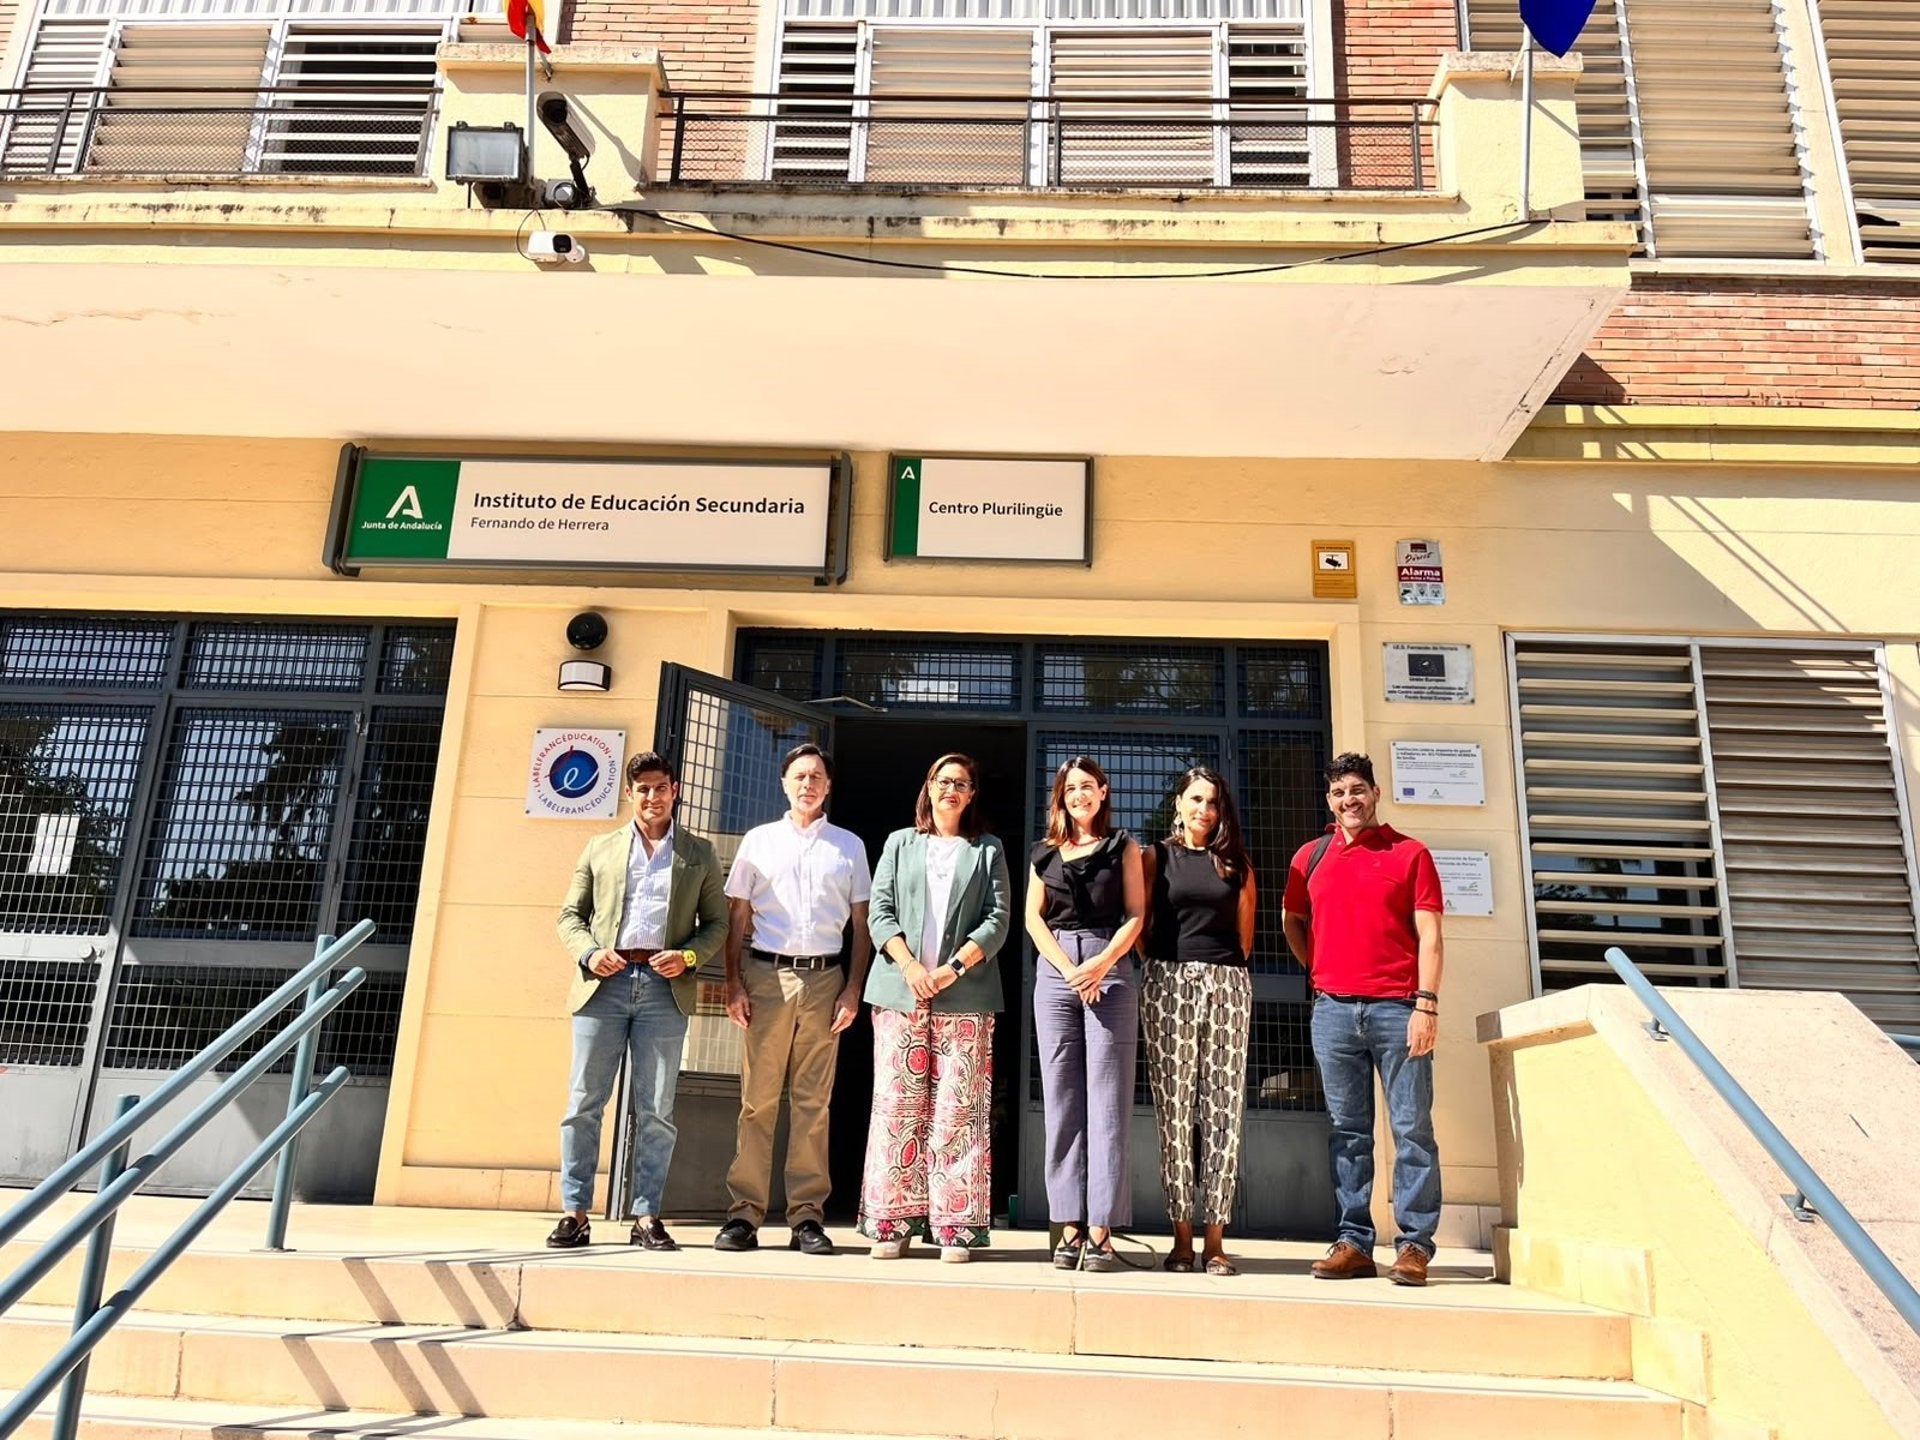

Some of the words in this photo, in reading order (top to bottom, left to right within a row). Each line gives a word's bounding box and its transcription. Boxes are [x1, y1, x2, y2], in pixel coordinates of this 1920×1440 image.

[473, 492, 557, 509] Instituto
[562, 493, 586, 510] de
[590, 494, 690, 512] Educación
[695, 497, 805, 514] Secundaria
[929, 501, 979, 515] Centro
[982, 502, 1063, 519] Plurilingüe
[361, 521, 386, 529] Junta
[388, 521, 399, 529] de
[400, 521, 442, 530] Andalucía
[470, 517, 535, 530] Fernando
[538, 518, 555, 530] de
[558, 519, 609, 531] Herrera
[1401, 567, 1441, 576] Alarma
